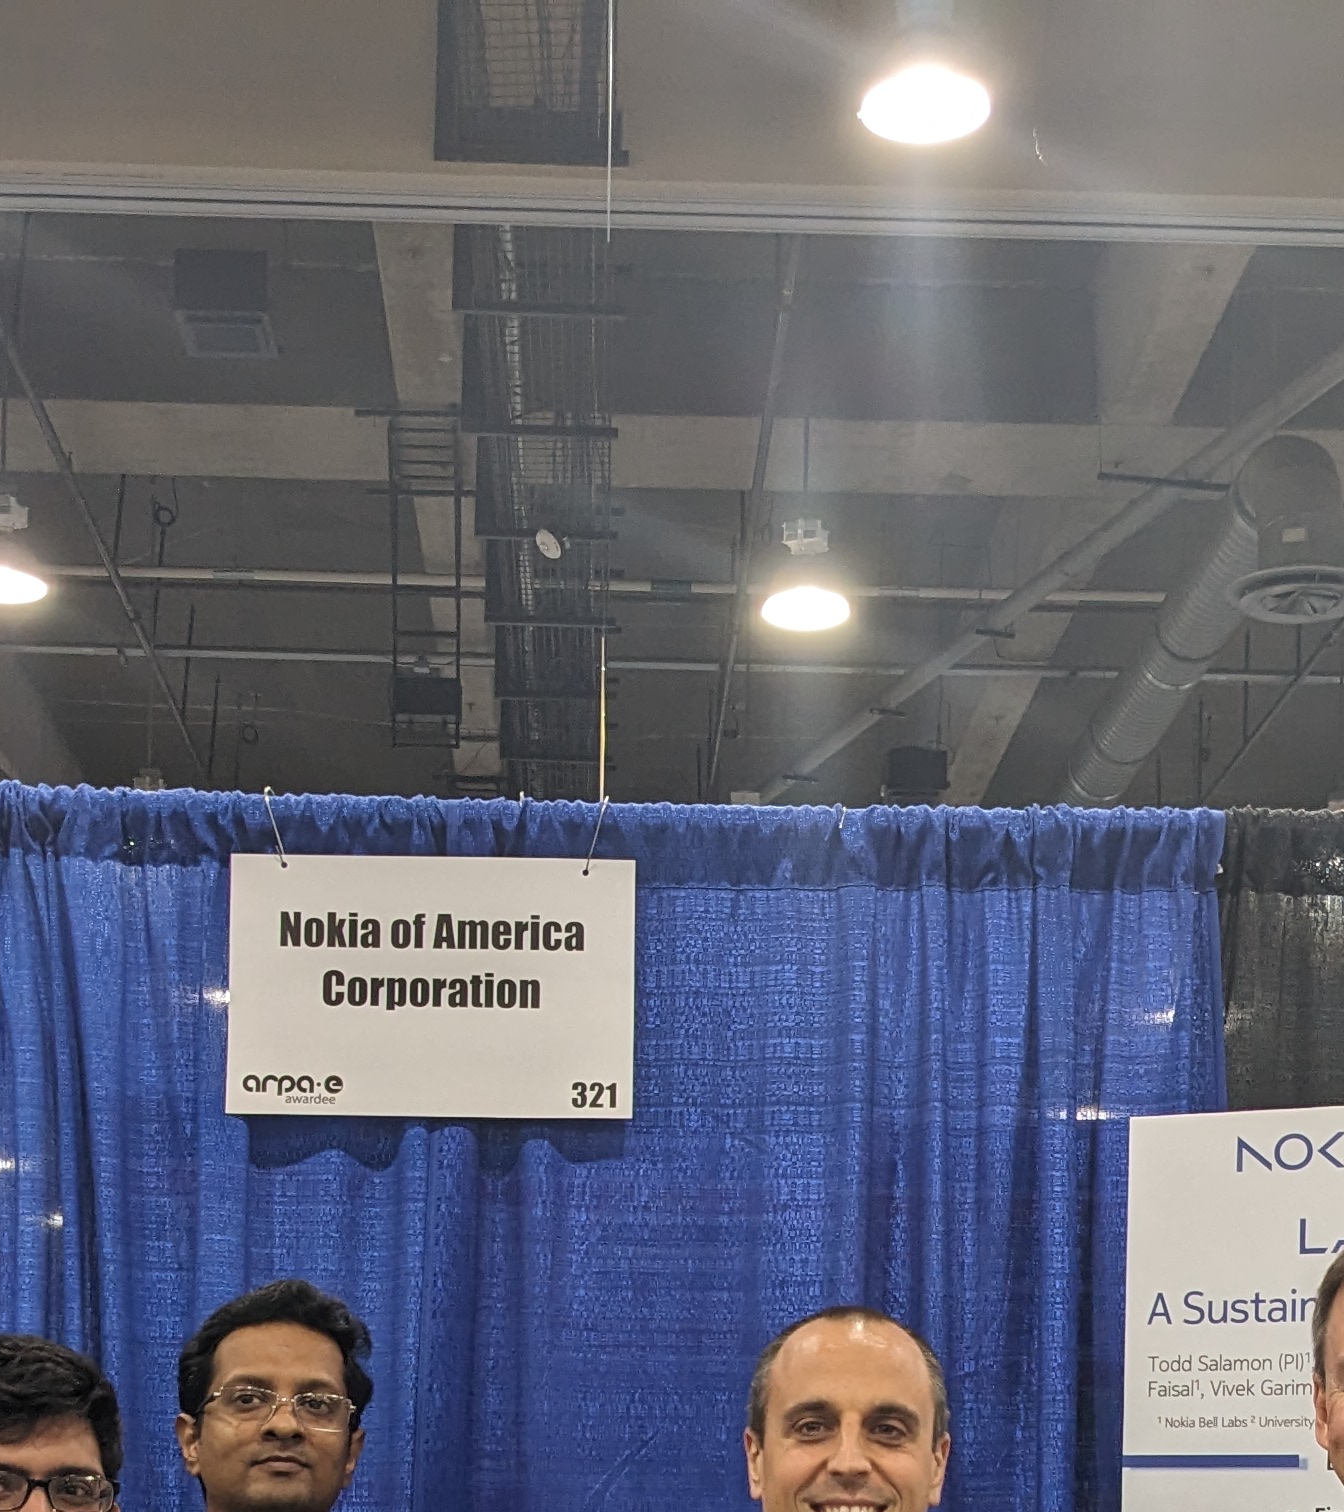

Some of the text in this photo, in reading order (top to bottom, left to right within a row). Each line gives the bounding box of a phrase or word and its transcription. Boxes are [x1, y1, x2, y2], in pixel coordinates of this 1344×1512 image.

[280, 911, 585, 951] Nokia of America
[322, 969, 541, 1010] Corporation
[285, 1092, 336, 1105] awardee
[571, 1081, 618, 1109] 321
[1147, 1292, 1173, 1326] A
[1182, 1288, 1319, 1326] Sustain
[1148, 1355, 1193, 1373] Todd
[1197, 1354, 1273, 1373] Salamon
[1210, 1379, 1256, 1398] Vivek
[1260, 1379, 1313, 1397] Garim
[1164, 1416, 1196, 1428] Nokia
[1198, 1416, 1218, 1428] Bell
[1221, 1415, 1248, 1428] Labs
[1259, 1415, 1315, 1430] University
